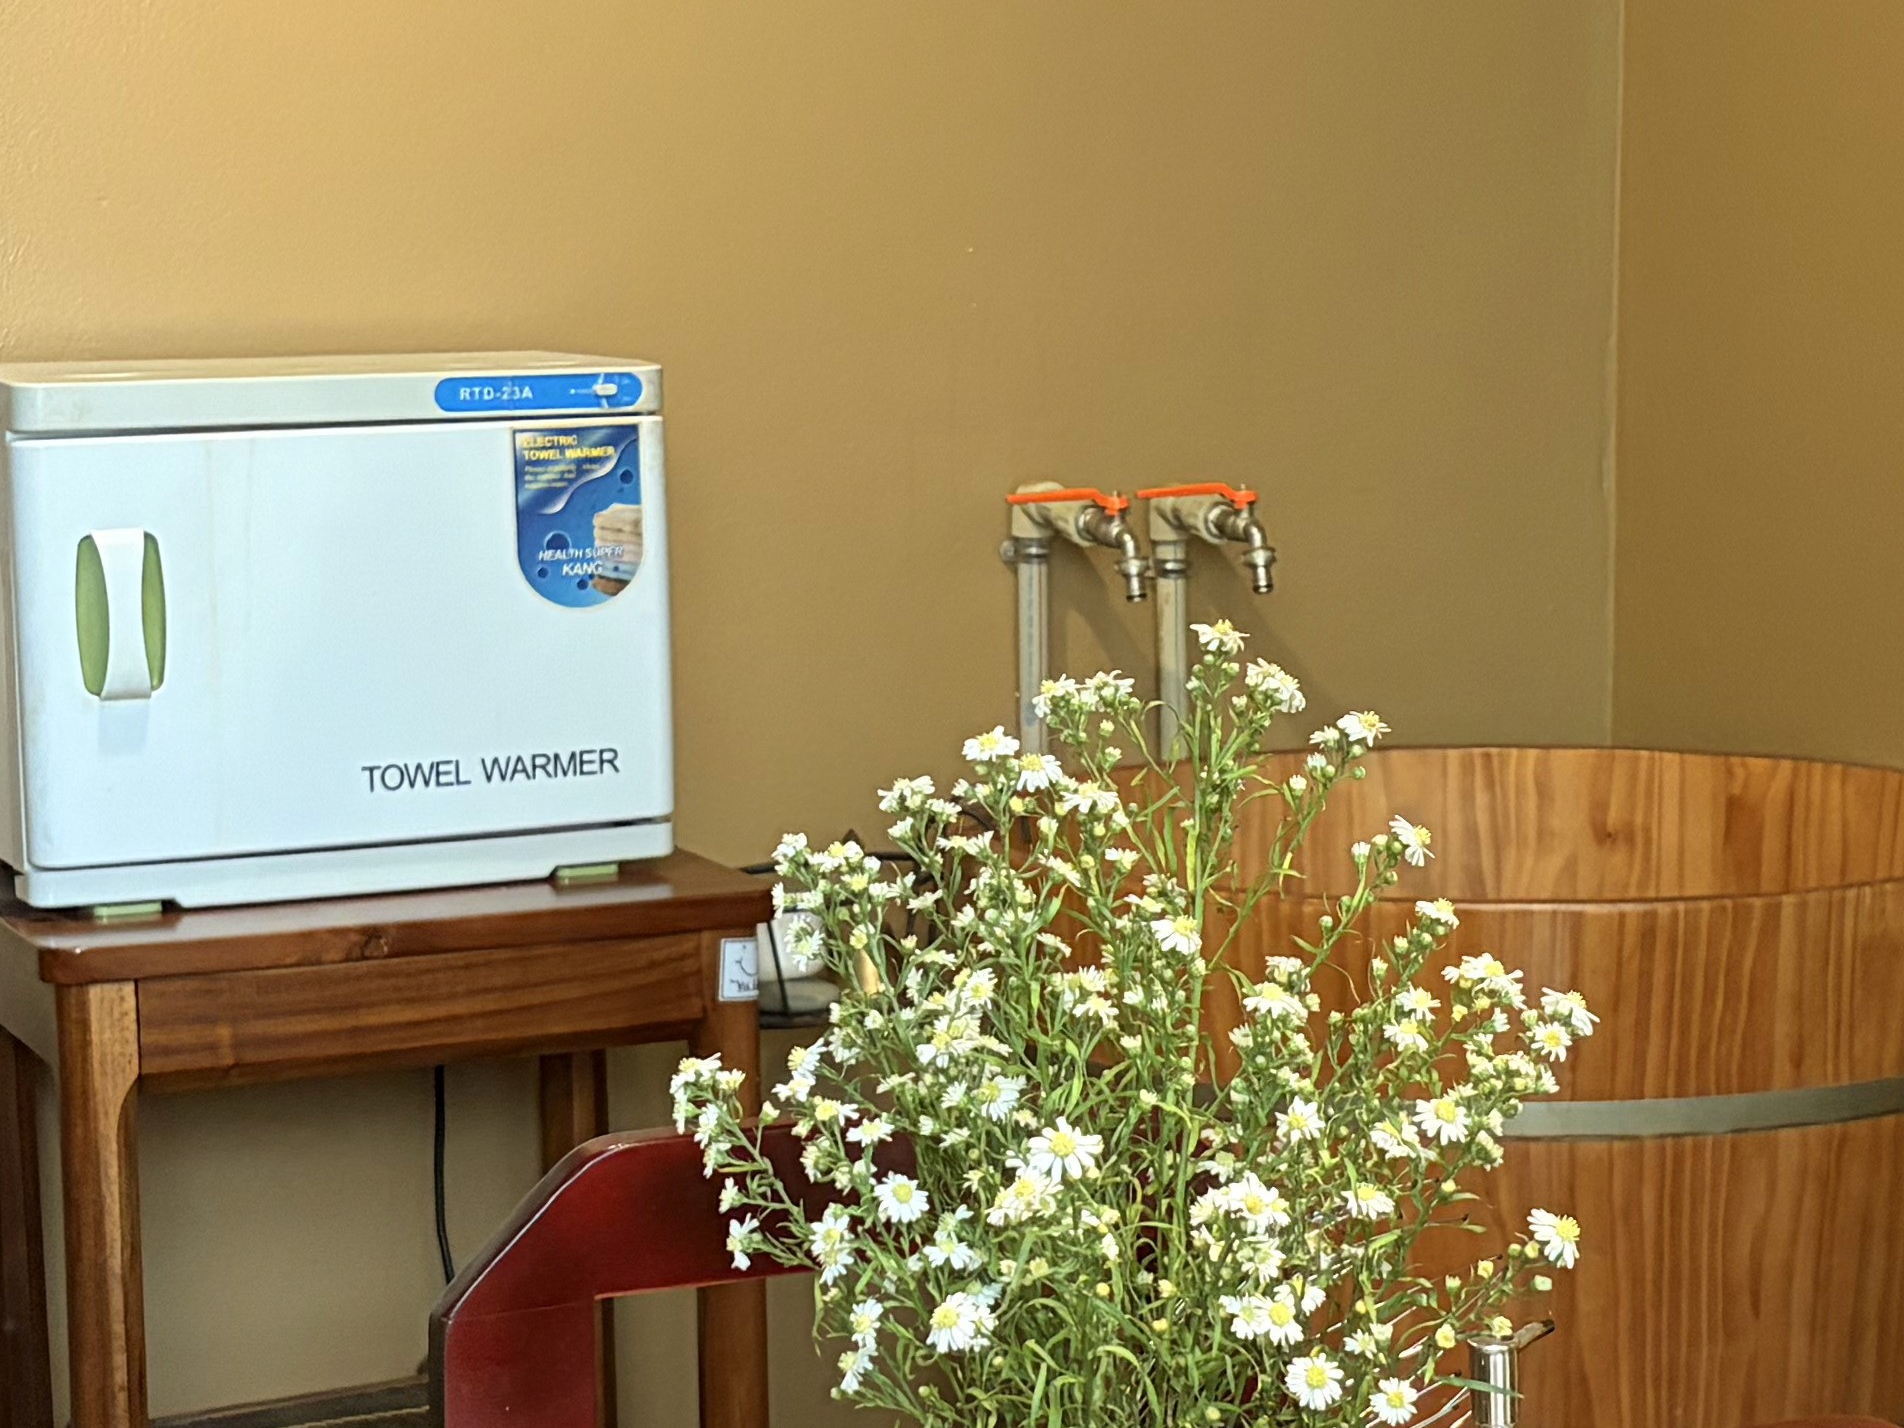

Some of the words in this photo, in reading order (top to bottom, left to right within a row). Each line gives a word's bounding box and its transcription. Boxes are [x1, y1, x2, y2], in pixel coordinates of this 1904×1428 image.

[521, 435, 577, 447] ELECTRIC
[523, 449, 562, 460] TOWEL
[565, 446, 615, 459] WARMER
[539, 549, 583, 561] HEALTH
[586, 545, 624, 558] SUPER
[562, 560, 603, 576] KANG
[361, 759, 472, 793] TOWEL
[481, 748, 620, 783] WARMER
